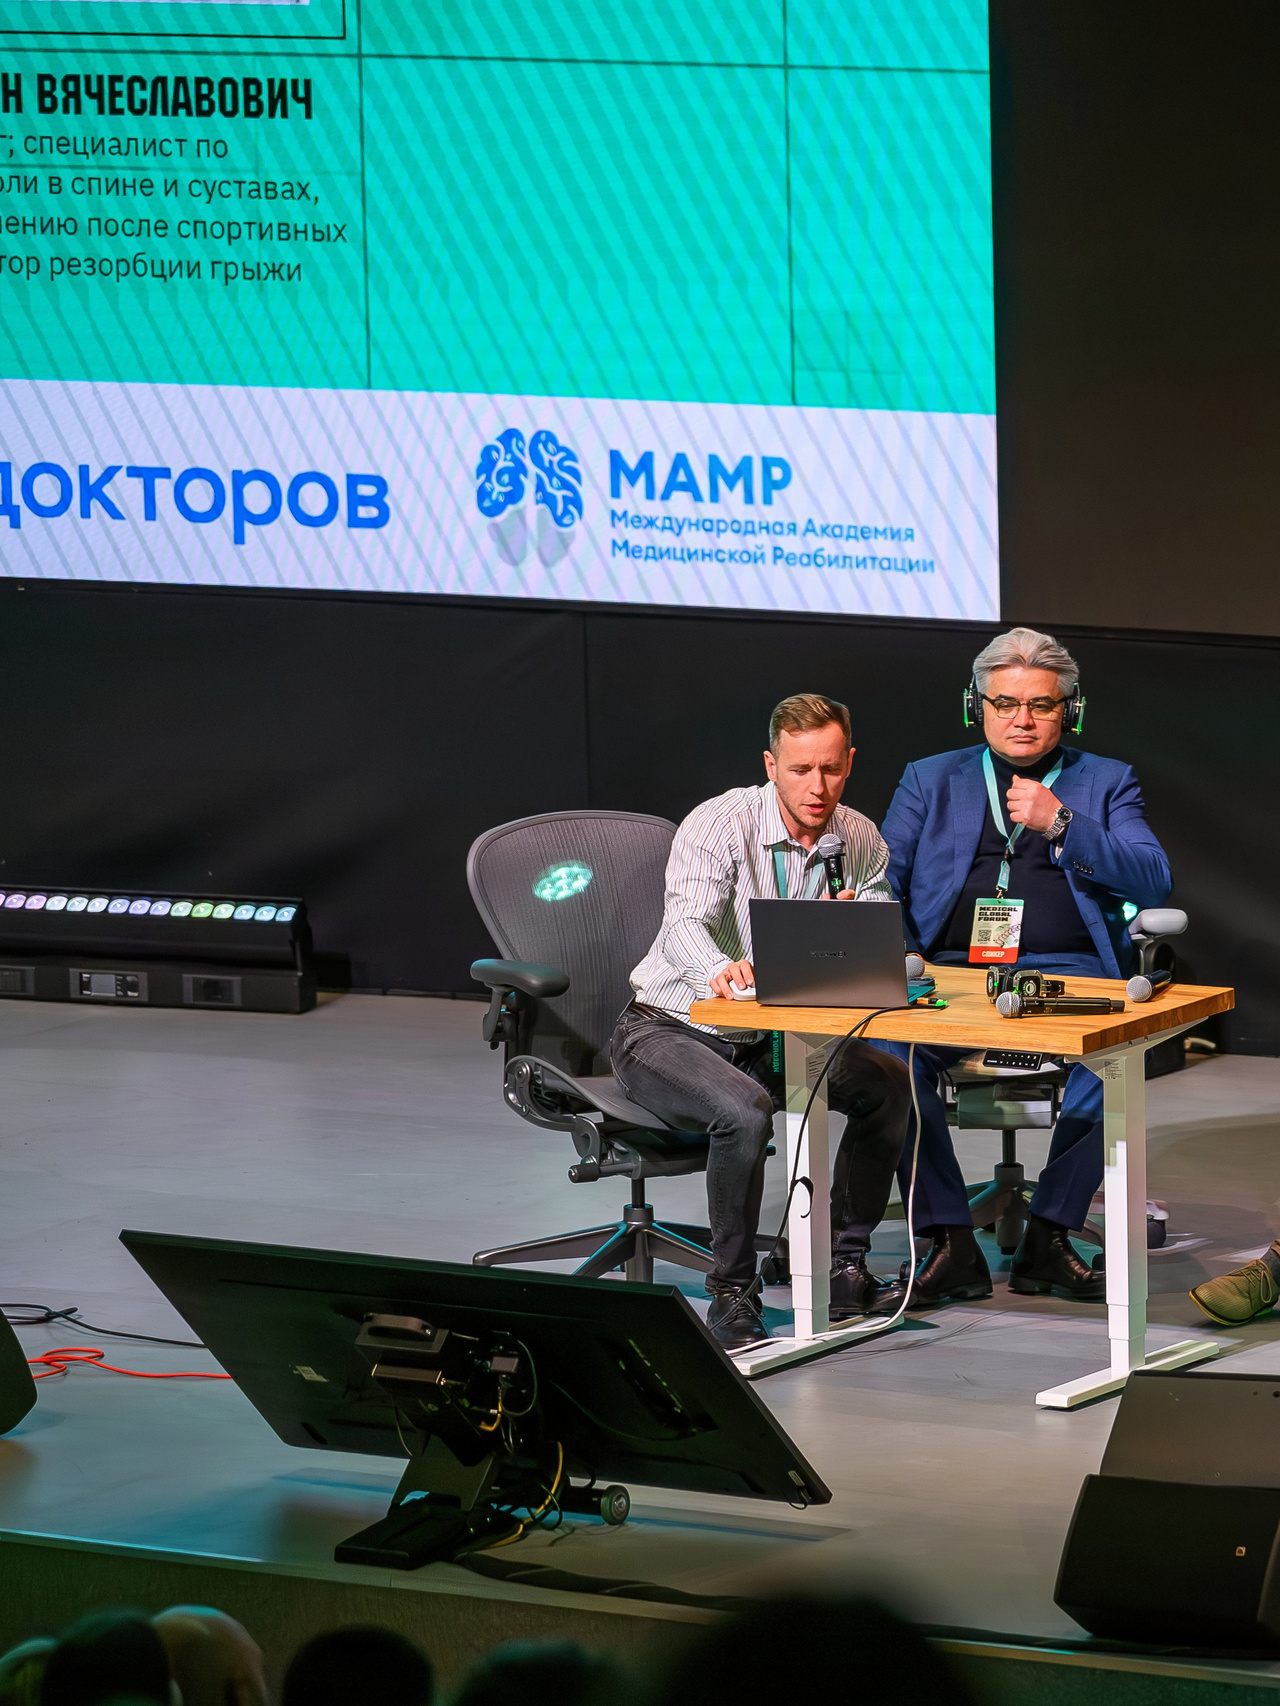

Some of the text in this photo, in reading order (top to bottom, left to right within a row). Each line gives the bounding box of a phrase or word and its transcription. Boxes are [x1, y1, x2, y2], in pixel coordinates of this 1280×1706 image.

[1, 72, 313, 120] Н ВЯЧЕСЛАВОВИЧ
[24, 135, 188, 160] специалист
[196, 139, 229, 158] по
[0, 175, 319, 206] ли в спине и суставах,
[0, 215, 347, 246] ению после спортивных
[50, 252, 201, 283] резорбции
[211, 260, 301, 287] грыжи
[609, 449, 793, 506] МАМР
[610, 509, 915, 542] Международная Академия
[611, 539, 936, 575] Медицинской Реабилитации
